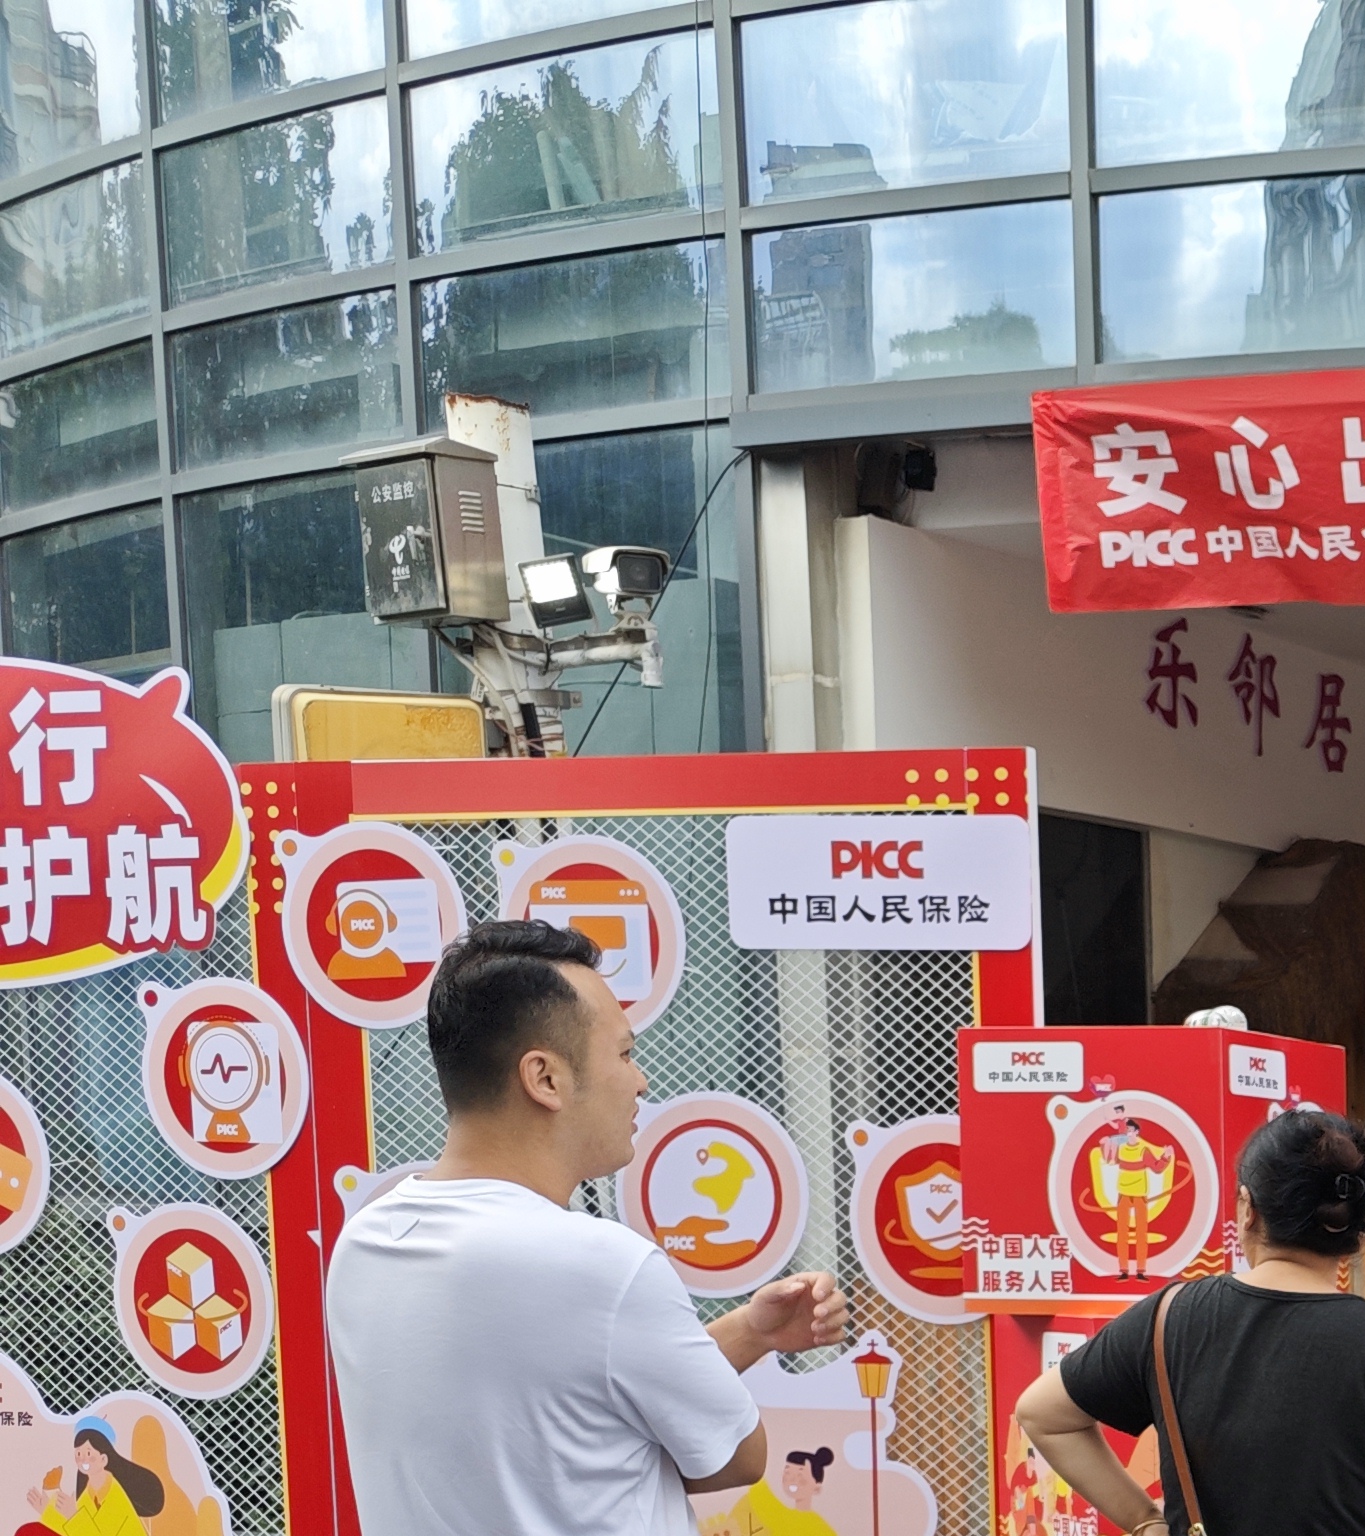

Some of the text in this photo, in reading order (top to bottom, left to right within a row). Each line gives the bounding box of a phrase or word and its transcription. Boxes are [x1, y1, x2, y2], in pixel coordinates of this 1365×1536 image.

[371, 480, 415, 503] 公安监控
[1099, 528, 1198, 568] PICC
[8, 686, 107, 806] 行
[831, 840, 924, 879] PICC
[0, 823, 207, 946] 护航
[541, 886, 566, 900] PICC
[769, 893, 990, 924] 中国人民保险
[350, 919, 375, 932] PICC
[1011, 1051, 1045, 1066] PICC
[988, 1070, 1069, 1084] 中国人民保险
[1237, 1074, 1278, 1091] 中国人民保险
[216, 1124, 238, 1136] PICC
[930, 1183, 952, 1194] PICC
[664, 1235, 696, 1250] PICC
[981, 1235, 1071, 1260] 中国人保
[982, 1270, 1072, 1293] 服务人民
[0, 1411, 33, 1427] 保险
